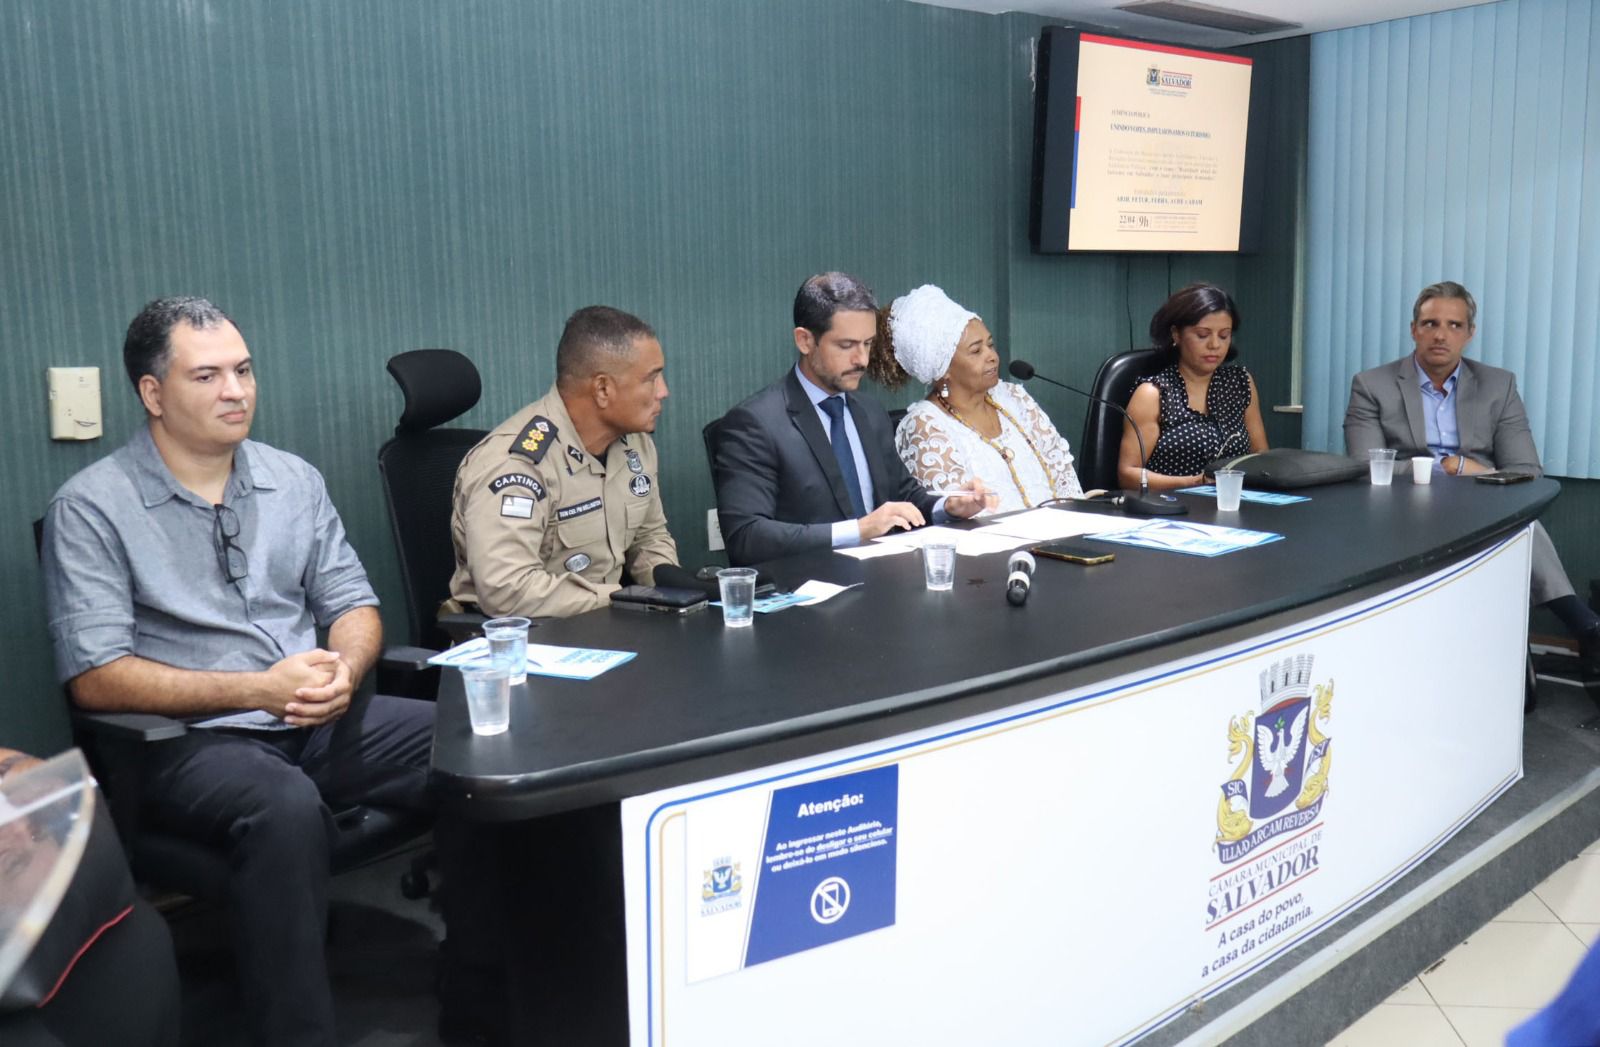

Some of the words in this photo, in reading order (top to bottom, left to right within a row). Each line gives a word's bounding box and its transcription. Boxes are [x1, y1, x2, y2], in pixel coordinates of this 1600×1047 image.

[1138, 215, 1149, 228] 9h
[495, 477, 542, 497] CAATINGA
[1227, 780, 1244, 797] SIC
[797, 793, 864, 818] Atenção:
[776, 842, 788, 851] Ao
[788, 834, 824, 848] ingressar
[824, 829, 847, 840] neste
[805, 845, 816, 855] de
[853, 833, 867, 843] seu
[868, 827, 893, 839] celular
[1250, 817, 1283, 848] ARCAM
[771, 864, 782, 873] ou
[814, 852, 827, 862] em
[827, 847, 849, 859] modo
[1254, 837, 1307, 873] MUNICIPAL
[1311, 829, 1323, 844] DE
[1205, 844, 1320, 926] SALVADOR
[1217, 931, 1227, 949] A
[1229, 918, 1255, 941] casa
[1257, 909, 1273, 925] do
[1275, 892, 1304, 920] povo,
[1201, 965, 1209, 978] a
[1211, 948, 1239, 972] casa
[1241, 938, 1256, 955] da
[1257, 905, 1314, 945] cidadania.
